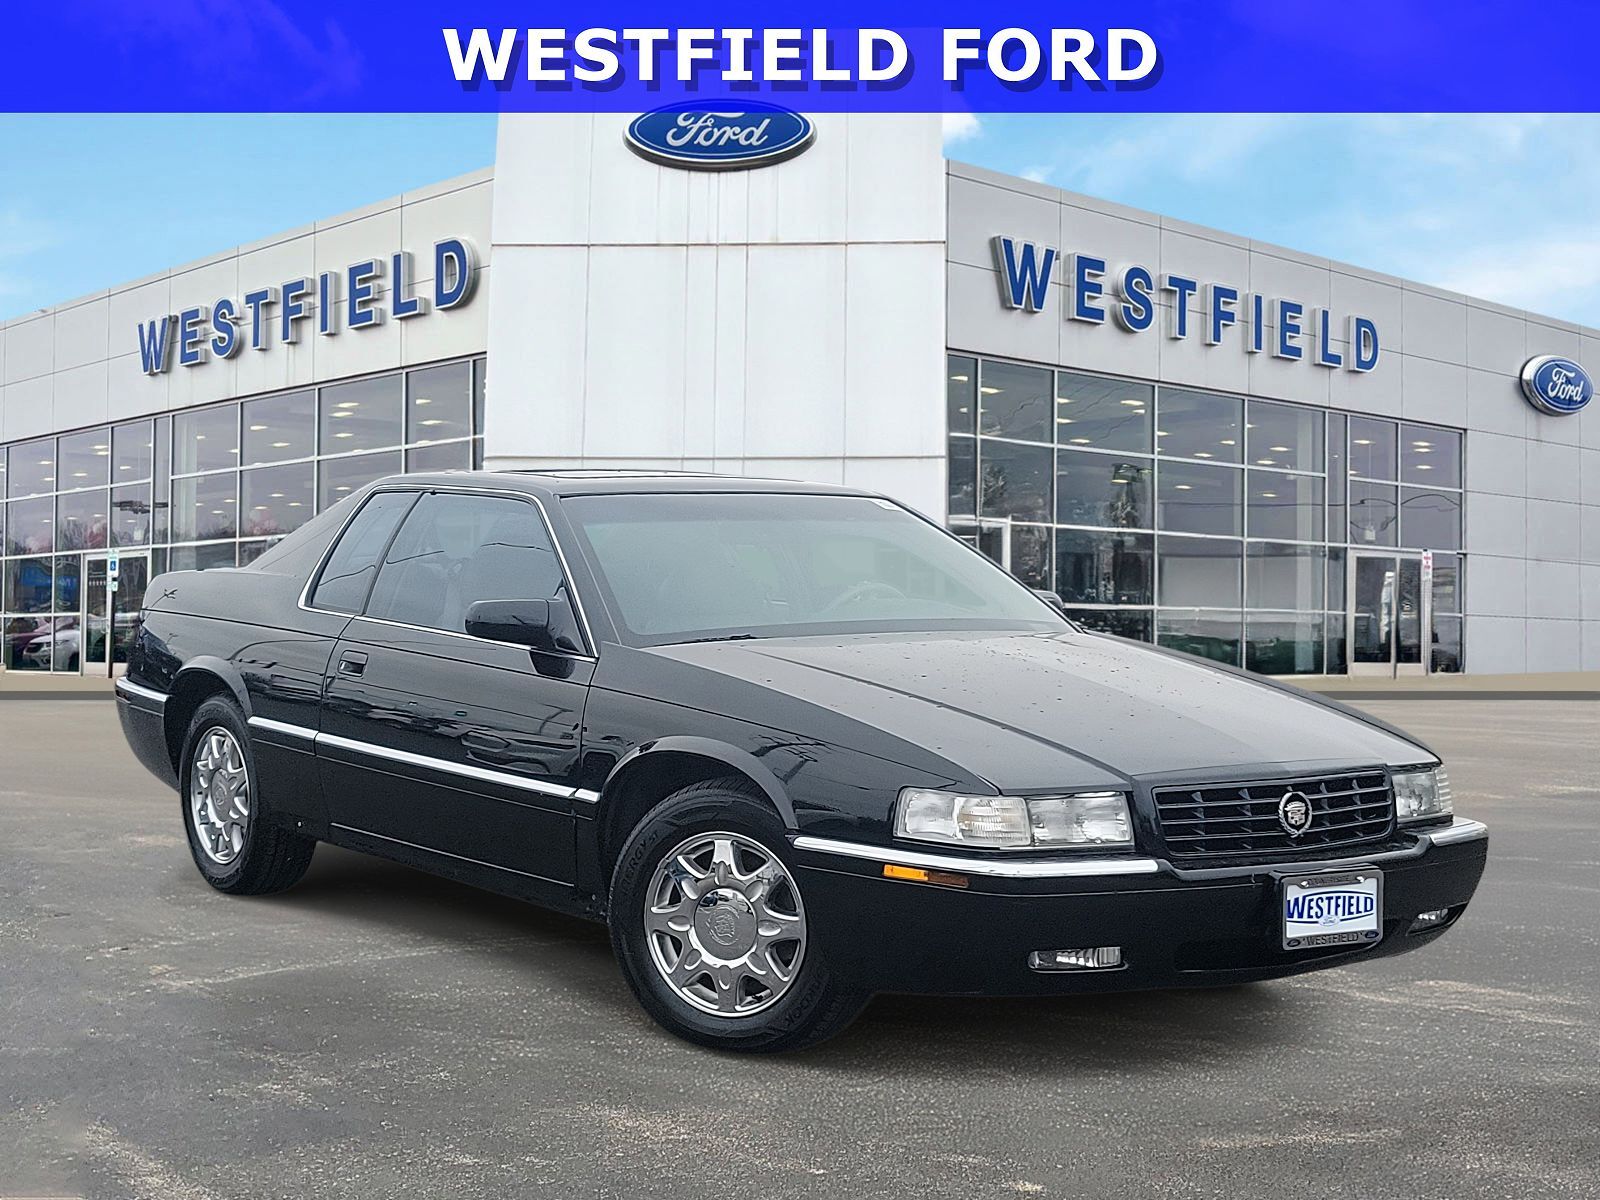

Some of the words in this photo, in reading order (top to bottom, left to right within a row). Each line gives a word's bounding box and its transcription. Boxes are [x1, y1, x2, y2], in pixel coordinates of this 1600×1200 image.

[666, 111, 771, 147] Ford
[137, 238, 474, 376] WESTFIELD
[992, 235, 1379, 373] WESTFIELD
[1547, 367, 1585, 402] Ford
[1286, 895, 1374, 919] WESTFIELD
[1307, 932, 1359, 946] WESTFIELD
